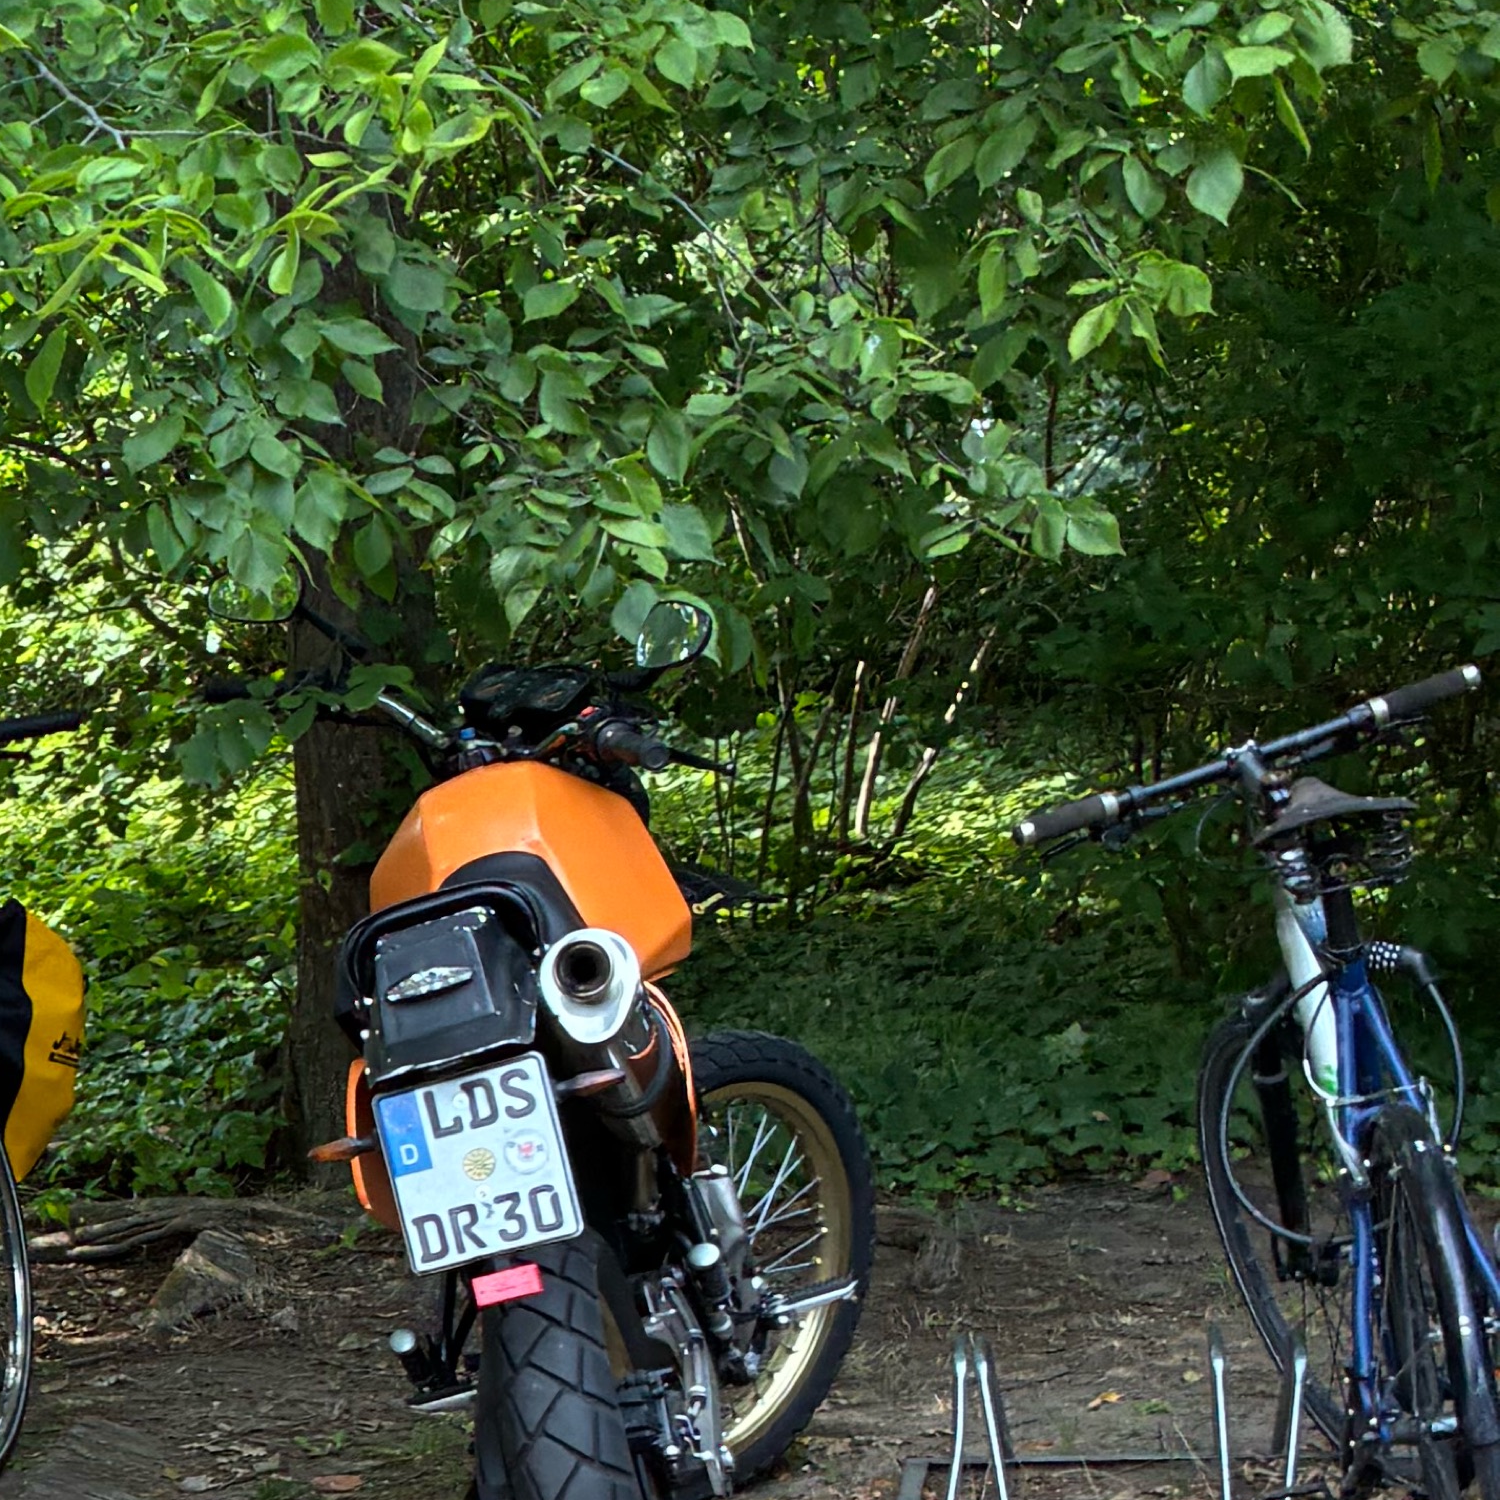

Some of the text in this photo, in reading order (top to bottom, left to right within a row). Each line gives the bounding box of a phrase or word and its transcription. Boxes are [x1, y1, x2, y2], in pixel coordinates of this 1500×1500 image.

[423, 1068, 537, 1139] LDS
[399, 1143, 420, 1166] D
[411, 1184, 564, 1265] DR 30
